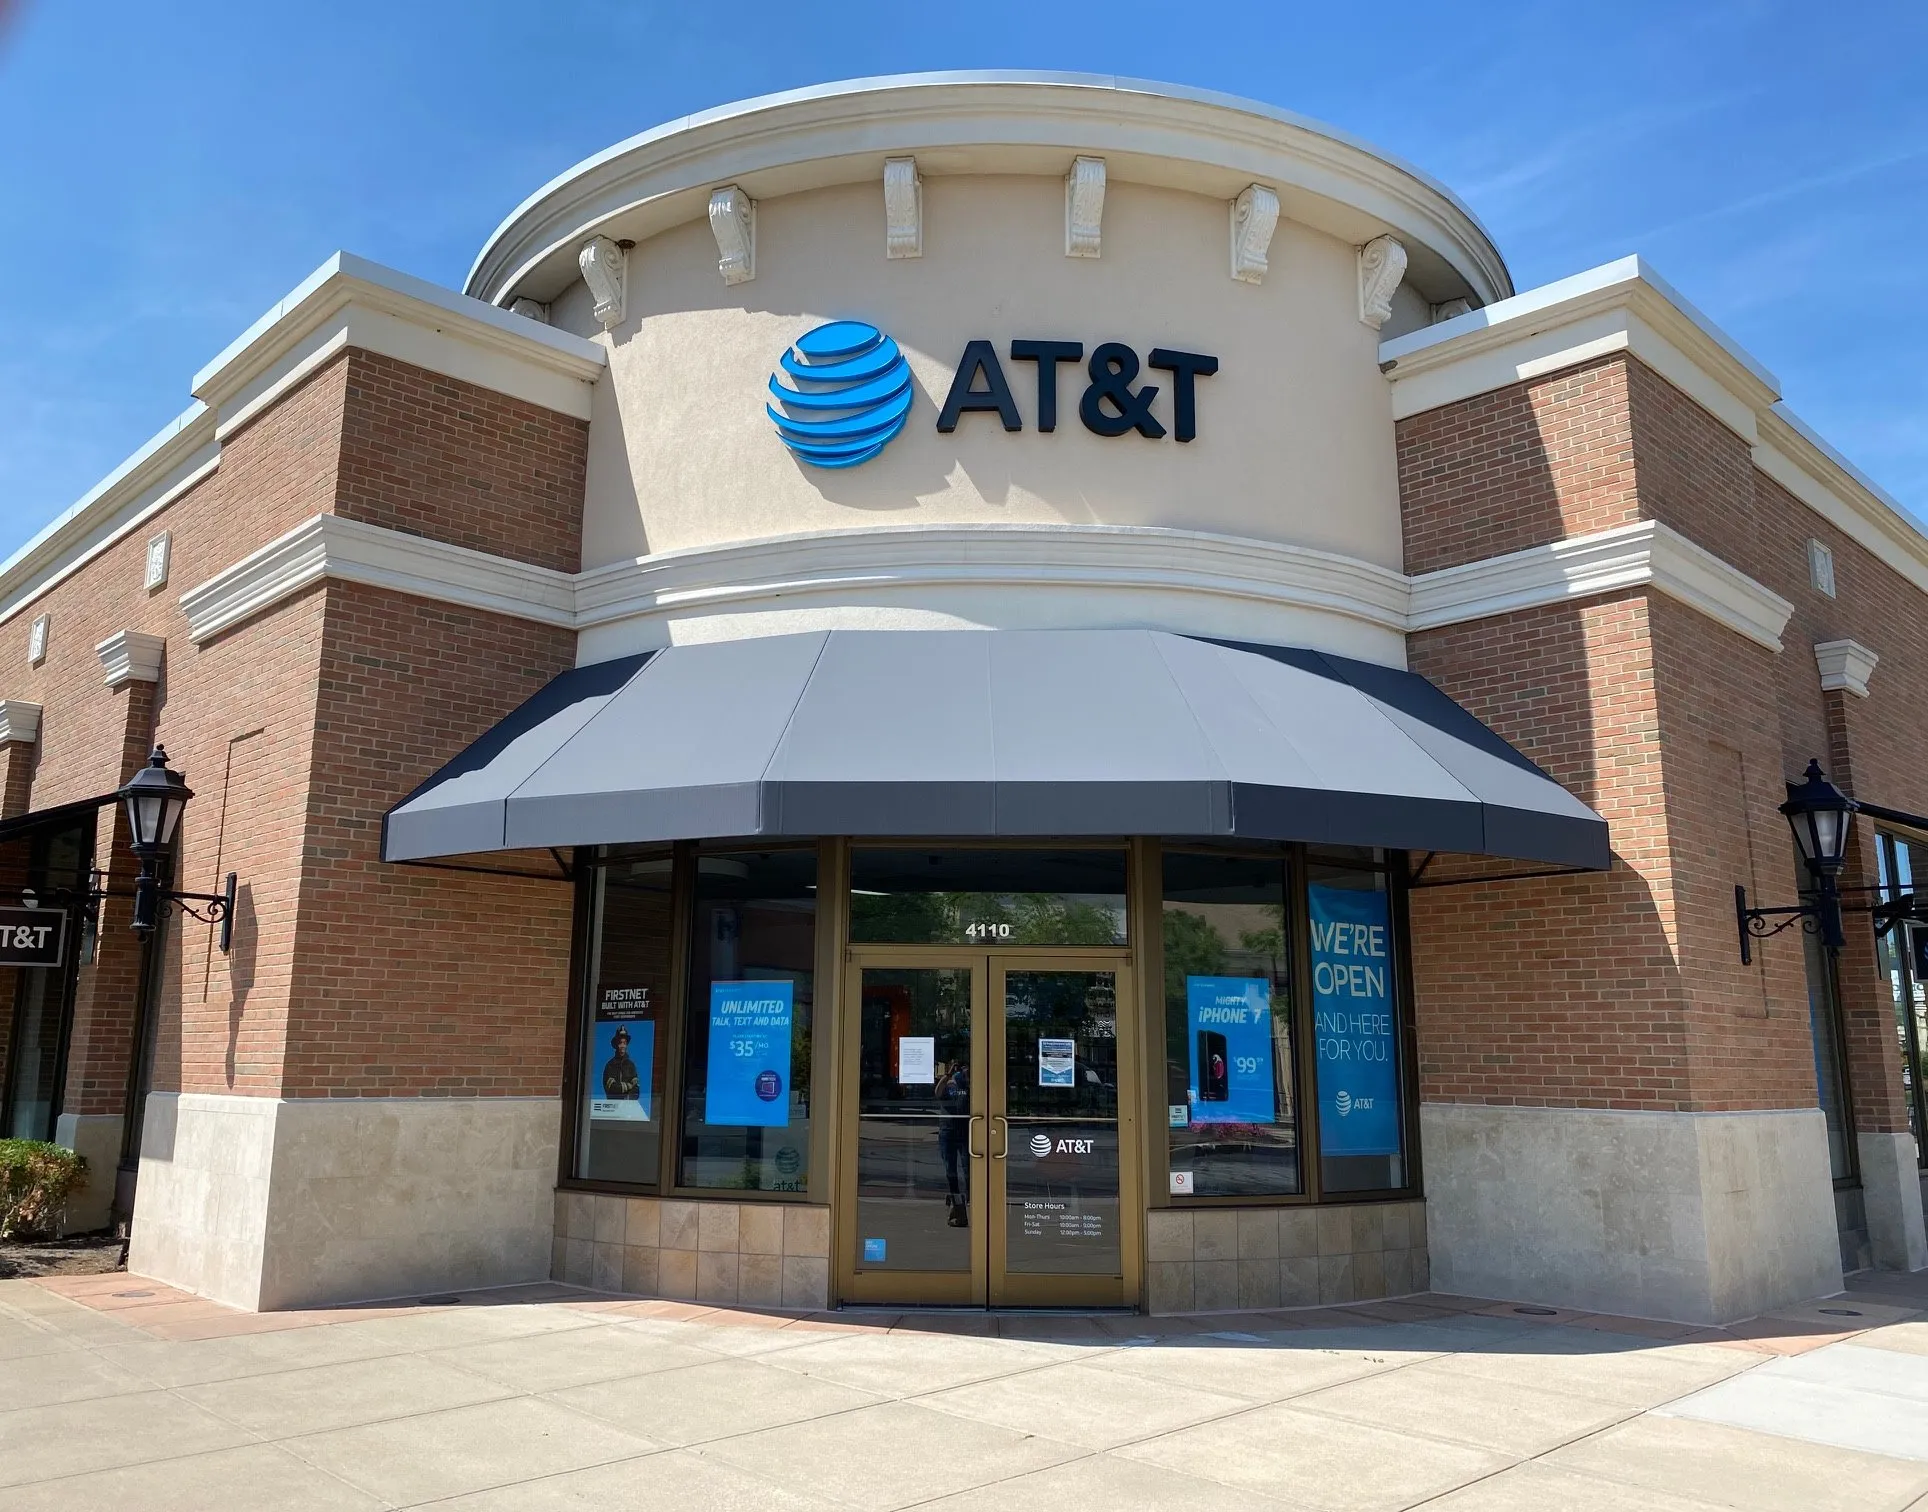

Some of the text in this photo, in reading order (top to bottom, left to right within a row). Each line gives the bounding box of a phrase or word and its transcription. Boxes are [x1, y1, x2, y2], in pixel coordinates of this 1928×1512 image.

[936, 339, 1219, 443] AT&T
[965, 923, 1010, 938] 4110
[1310, 919, 1386, 957] WE'RE
[1314, 961, 1384, 998] OPEN
[605, 988, 648, 1000] FIRSTNET
[601, 1000, 650, 1010] BUILT WITH AT&T
[720, 1000, 784, 1014] UNLIMITED
[734, 1016, 753, 1026] TEXT
[753, 1016, 769, 1026] AND
[770, 1016, 789, 1026] DATA
[1198, 1006, 1262, 1024] iPHONE 7
[1314, 1011, 1391, 1036] AND HERE
[1319, 1038, 1389, 1062] FOR YOU.
[1353, 1098, 1375, 1110] AT&T
[1056, 1139, 1094, 1153] AT&T
[1024, 1201, 1065, 1210] Store Hours
